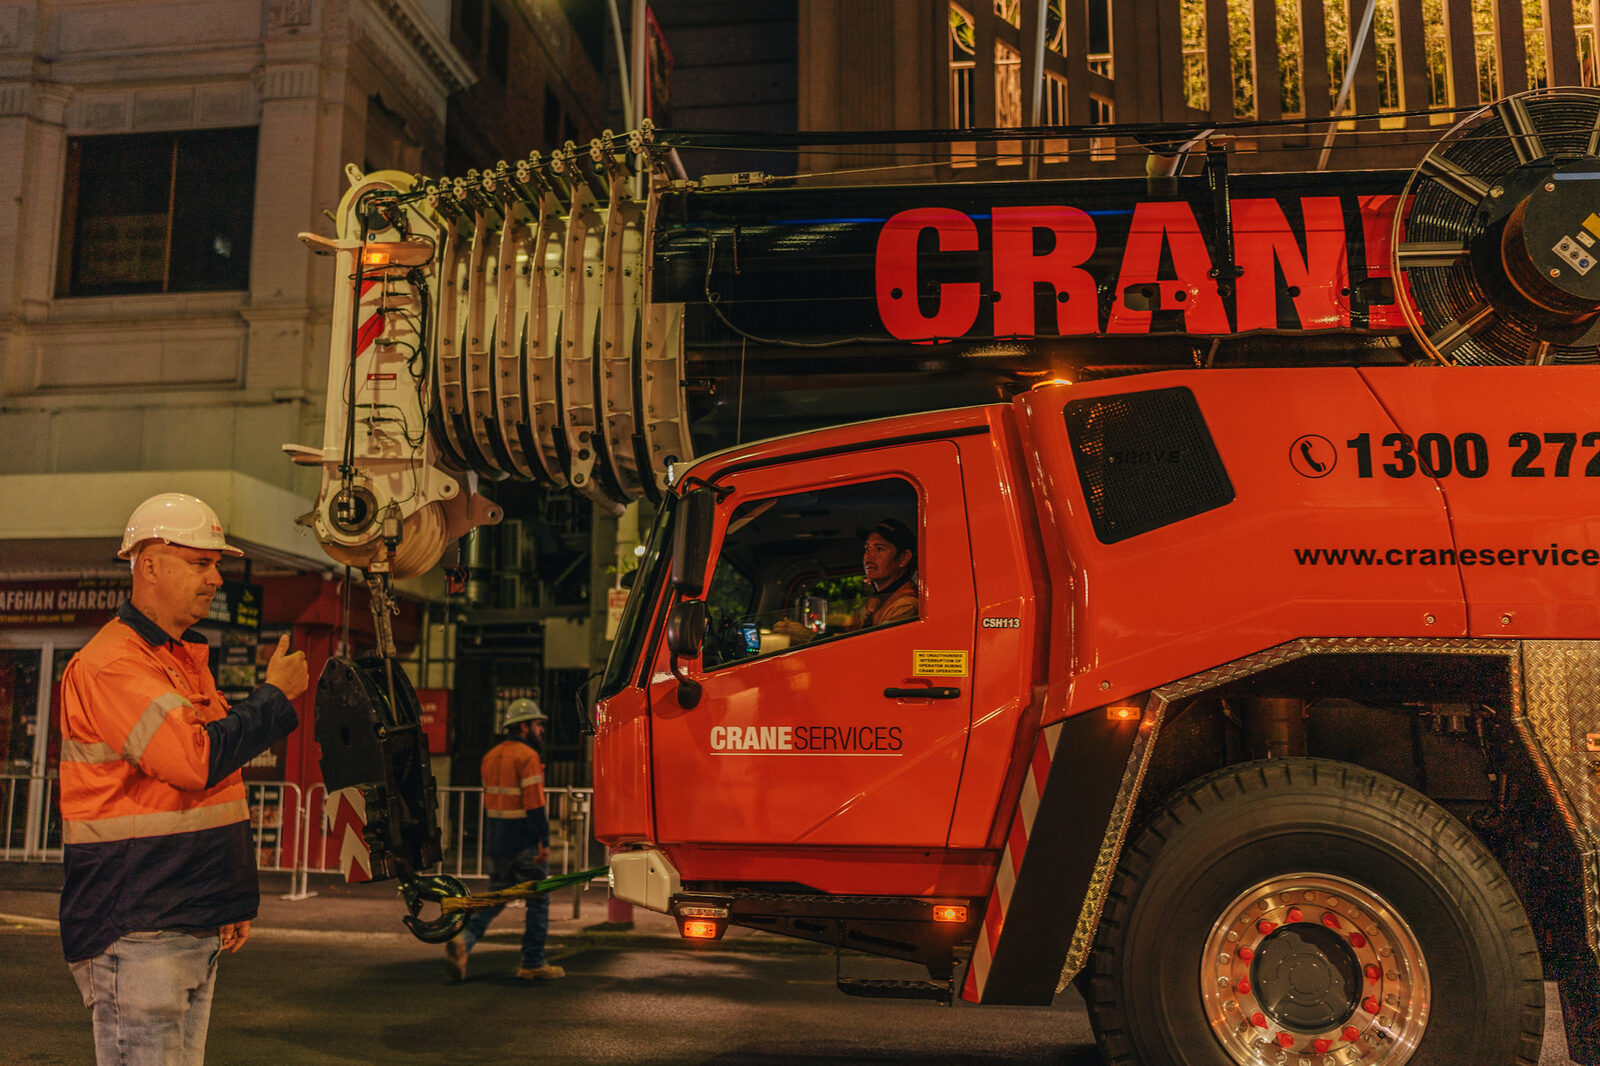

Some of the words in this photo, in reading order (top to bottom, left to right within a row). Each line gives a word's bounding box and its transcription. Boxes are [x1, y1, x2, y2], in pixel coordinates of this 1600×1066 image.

[1346, 432, 1490, 479] 1300
[1507, 431, 1600, 478] 272
[1293, 543, 1600, 567] www.craneservice
[0, 590, 54, 610] AFGHAN
[982, 616, 1020, 628] CSH113
